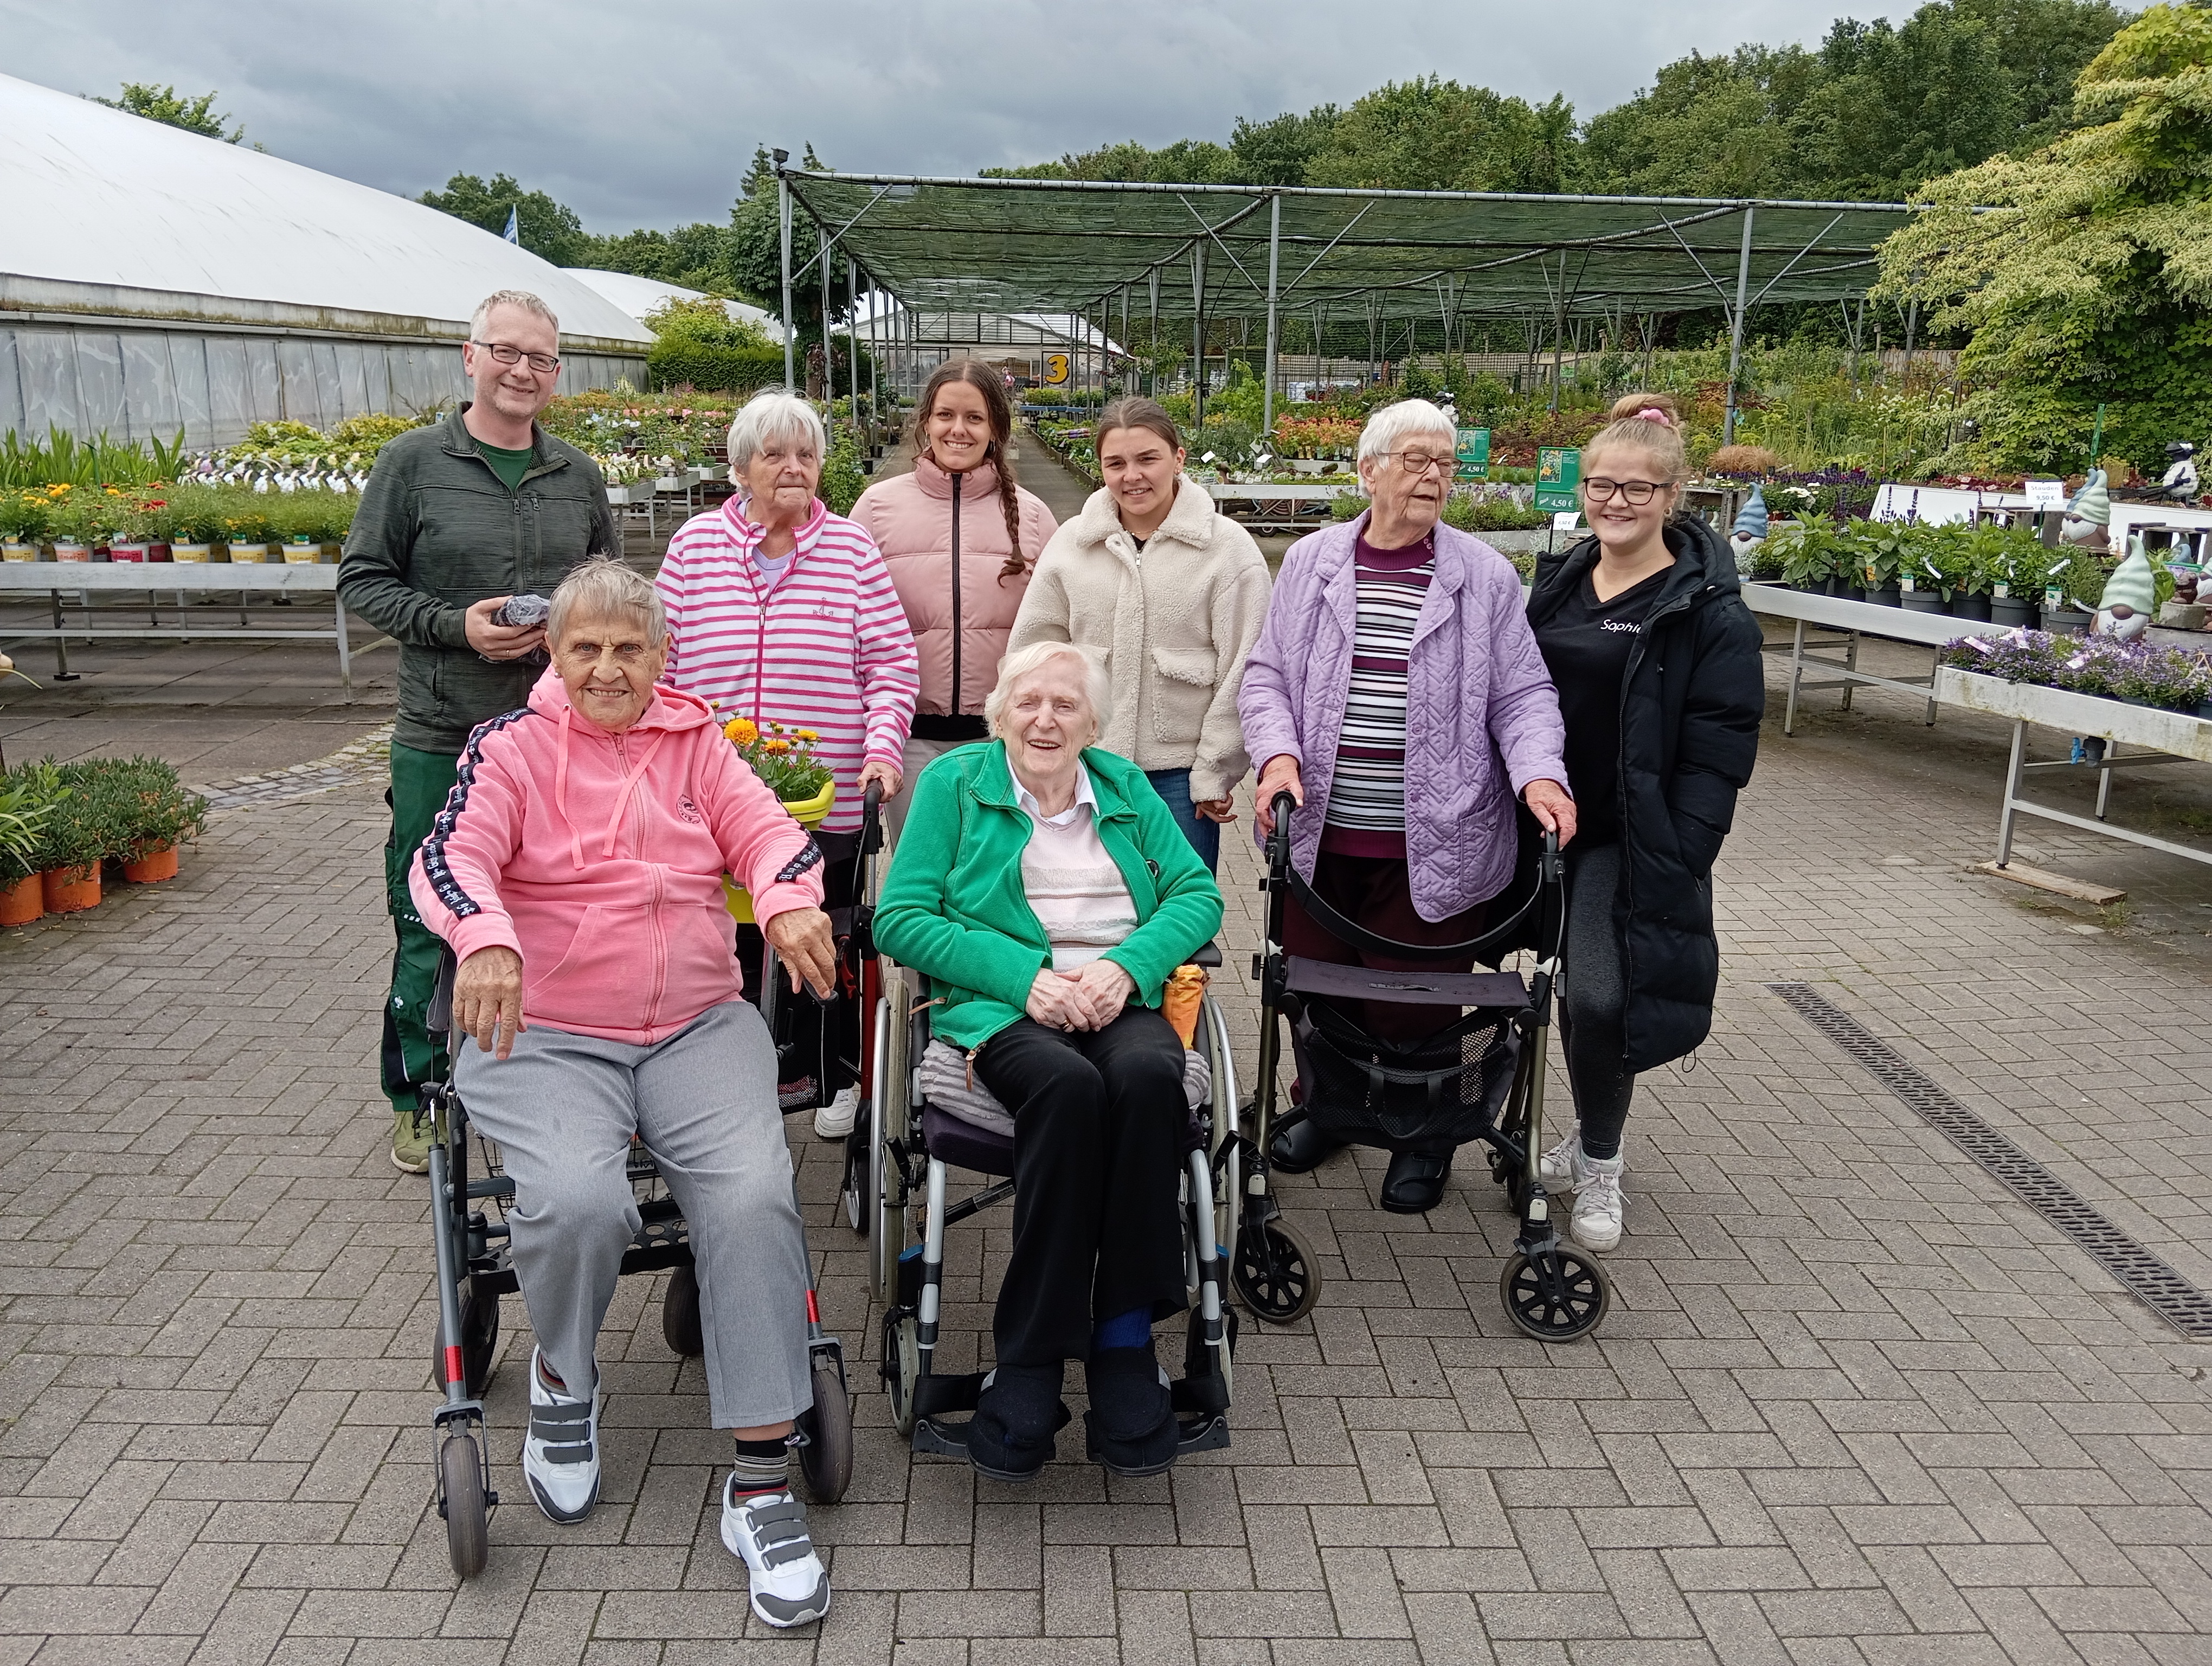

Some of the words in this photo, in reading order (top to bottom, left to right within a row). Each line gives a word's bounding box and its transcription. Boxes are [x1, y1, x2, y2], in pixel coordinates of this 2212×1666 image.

[1045, 355, 1069, 385] 3
[1551, 499, 1567, 508] 4,50
[1568, 499, 1573, 508] €
